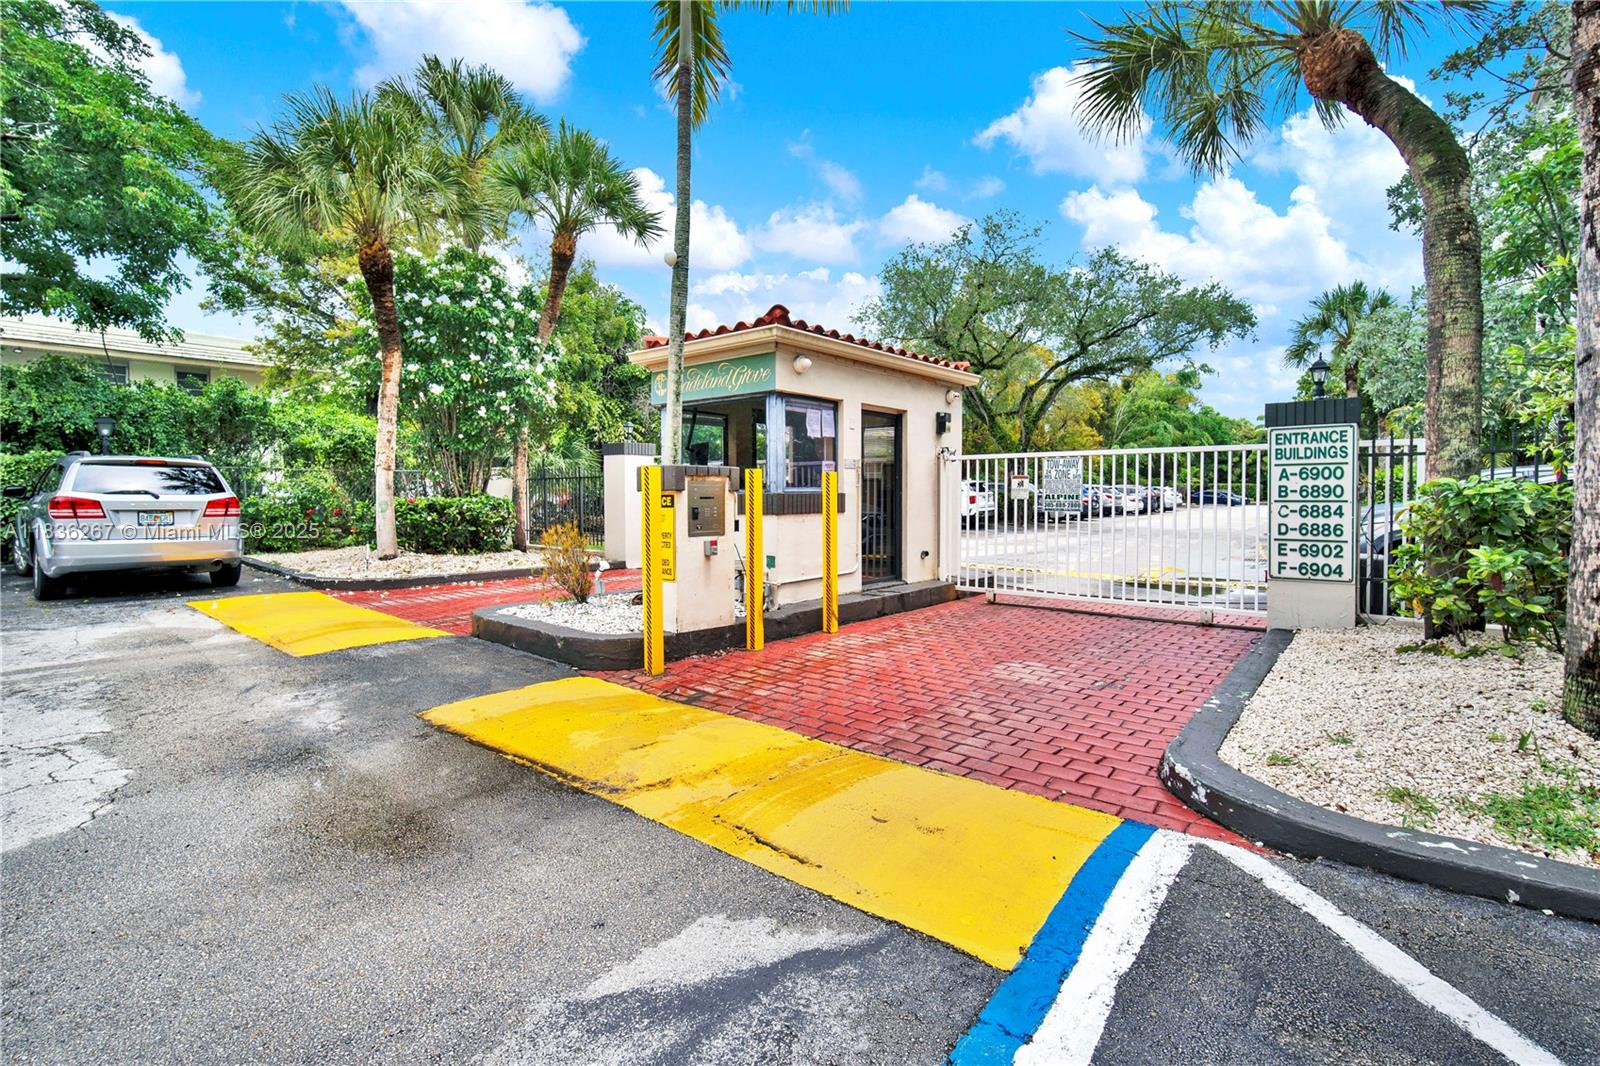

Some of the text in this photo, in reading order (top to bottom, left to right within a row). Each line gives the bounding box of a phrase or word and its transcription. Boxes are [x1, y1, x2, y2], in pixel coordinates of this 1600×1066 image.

[719, 362, 772, 392] Grove
[1275, 430, 1348, 445] ENTRANCE
[1275, 445, 1349, 460] BUILDINGS
[1046, 459, 1080, 469] TOW-AWAY
[1054, 469, 1071, 480] ZONE
[1278, 466, 1344, 481] A-6900
[1278, 484, 1344, 498] B-6890
[661, 496, 671, 506] CE
[1278, 505, 1344, 519] C-6884
[1278, 523, 1344, 537] D-6886
[1278, 543, 1344, 558] E-6902
[1278, 562, 1344, 578] F-6904
